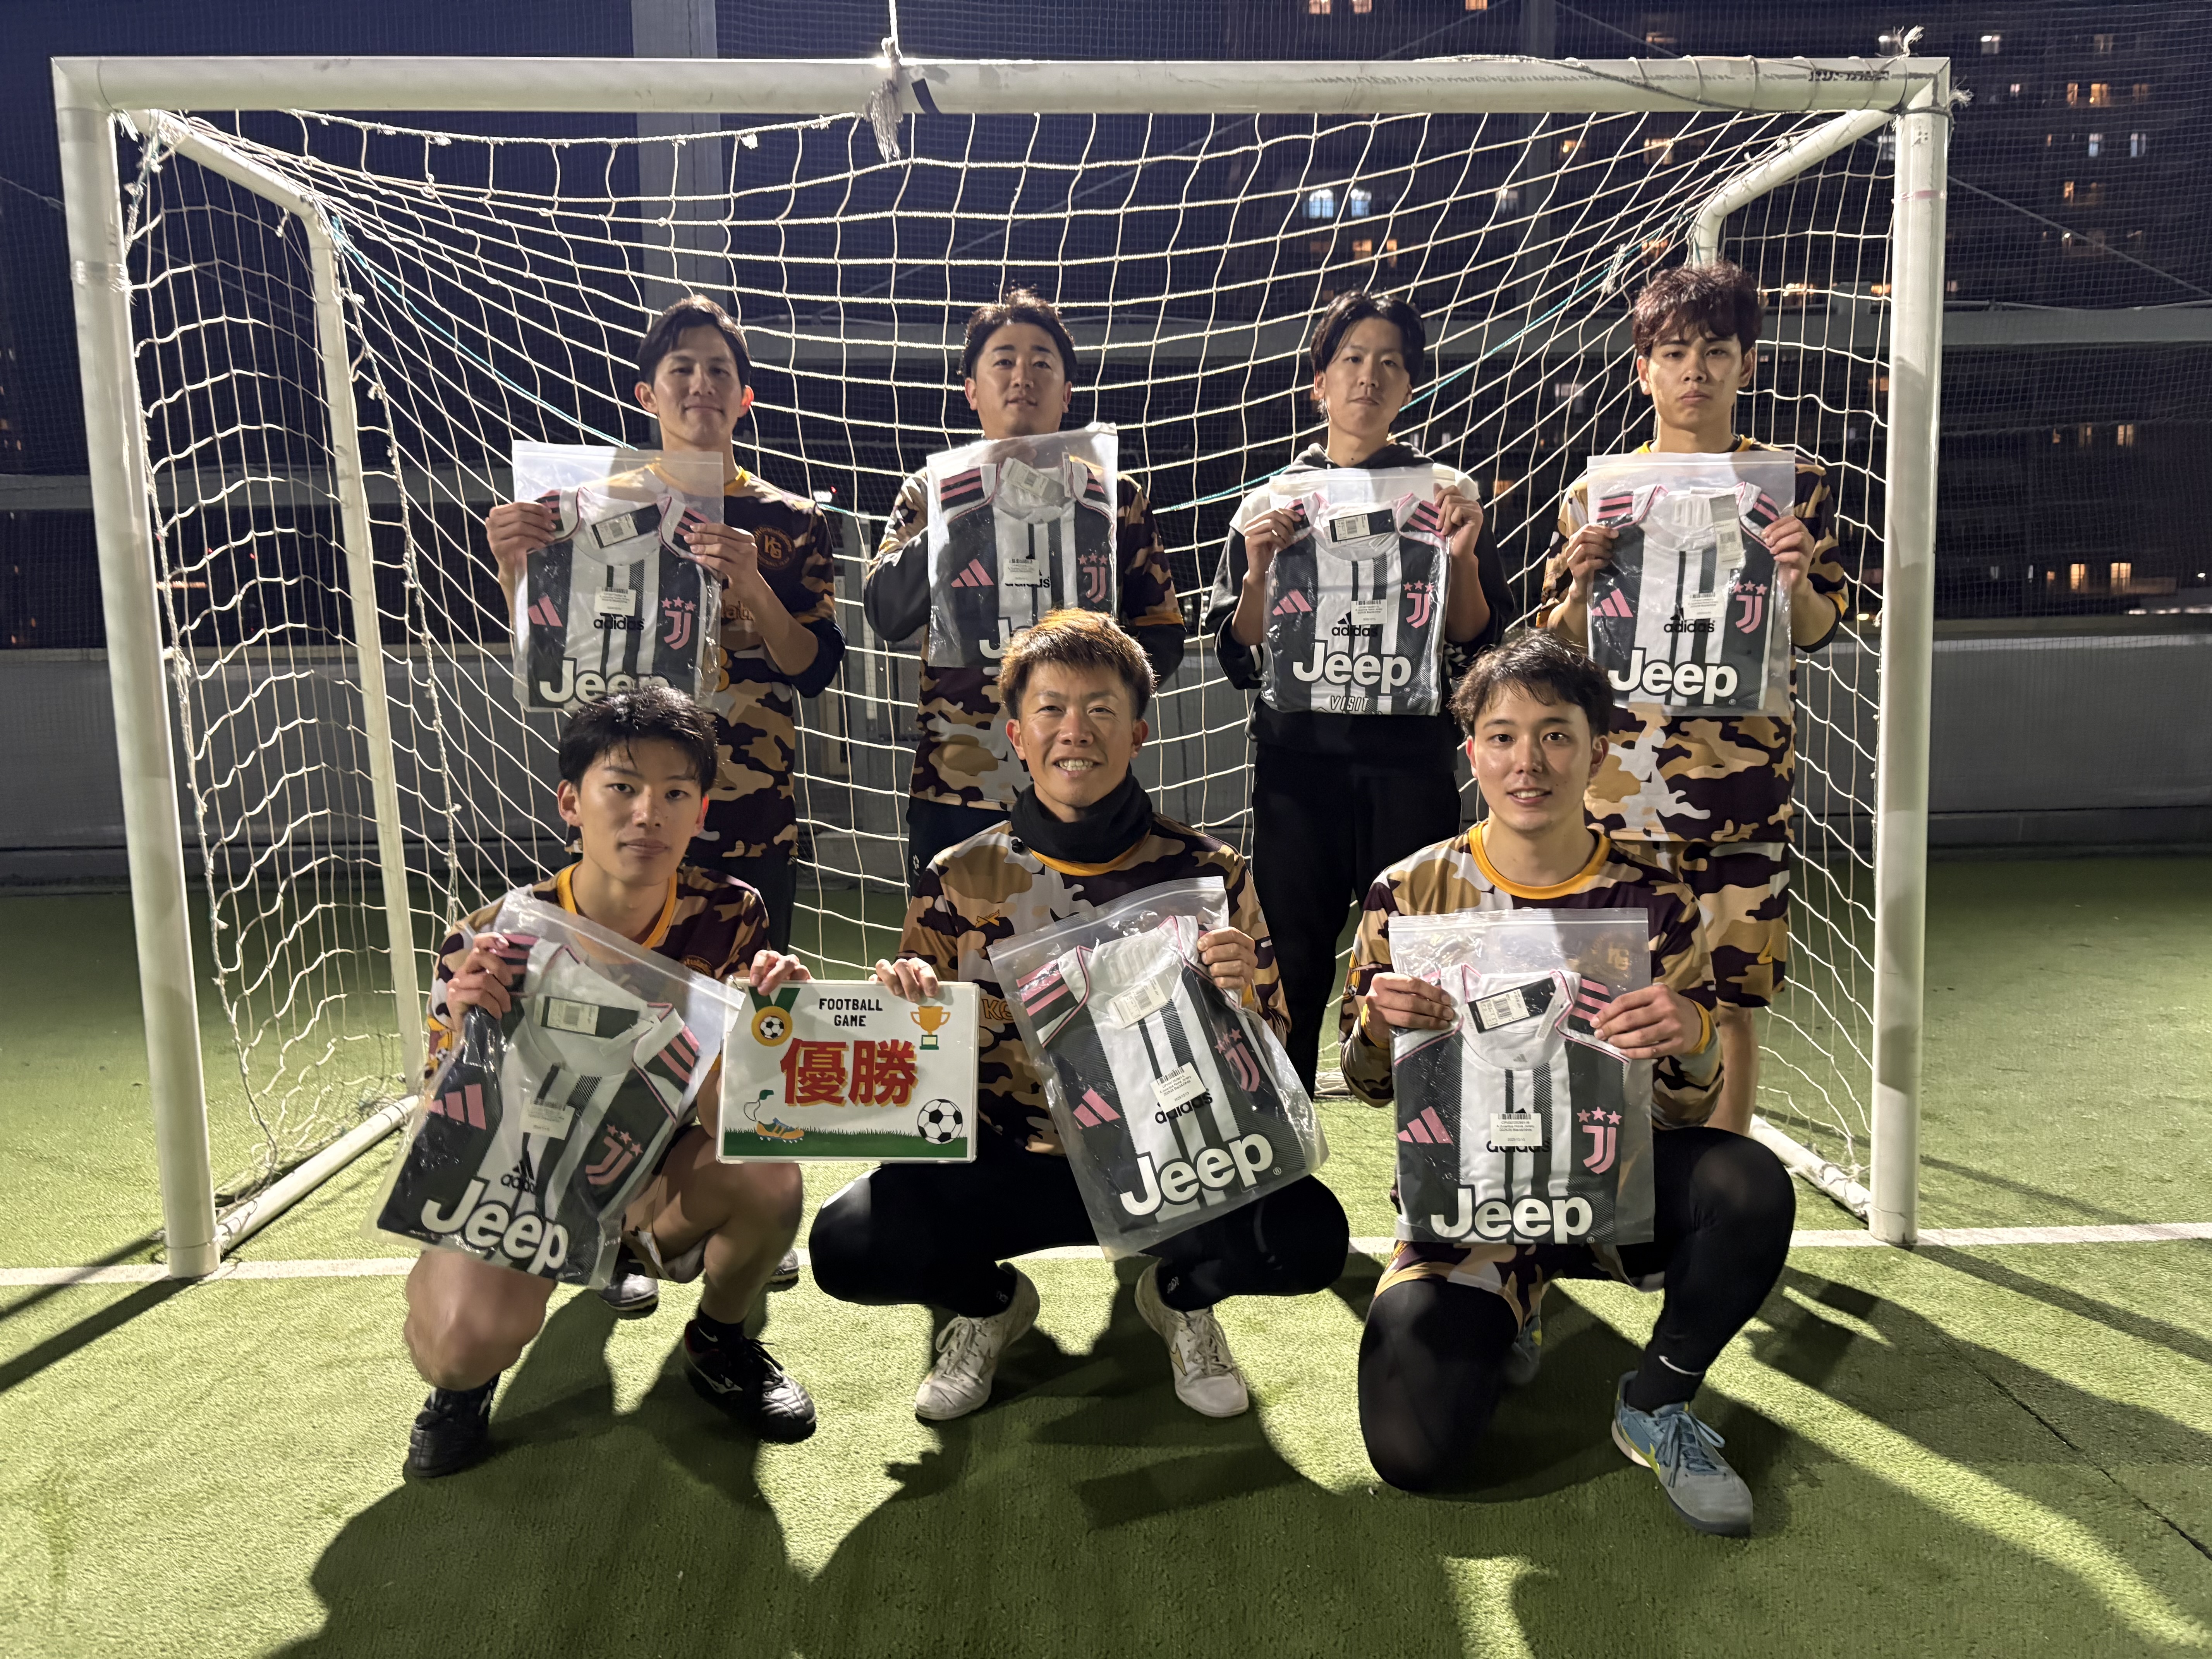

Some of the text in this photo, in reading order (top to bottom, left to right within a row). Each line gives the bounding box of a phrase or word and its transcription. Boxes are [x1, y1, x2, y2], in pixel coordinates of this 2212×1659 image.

[1664, 620, 1715, 633] adidas
[1293, 642, 1412, 693] Jeep
[1608, 650, 1738, 705] Jeep
[1331, 696, 1369, 711] VISIT
[819, 998, 883, 1012] FOOTBALL
[834, 1015, 866, 1027] GAME
[780, 1037, 919, 1108] 優勝
[1120, 1133, 1273, 1216] Jeep
[421, 1179, 568, 1273] Jeep
[1431, 1188, 1593, 1244] Jeep
